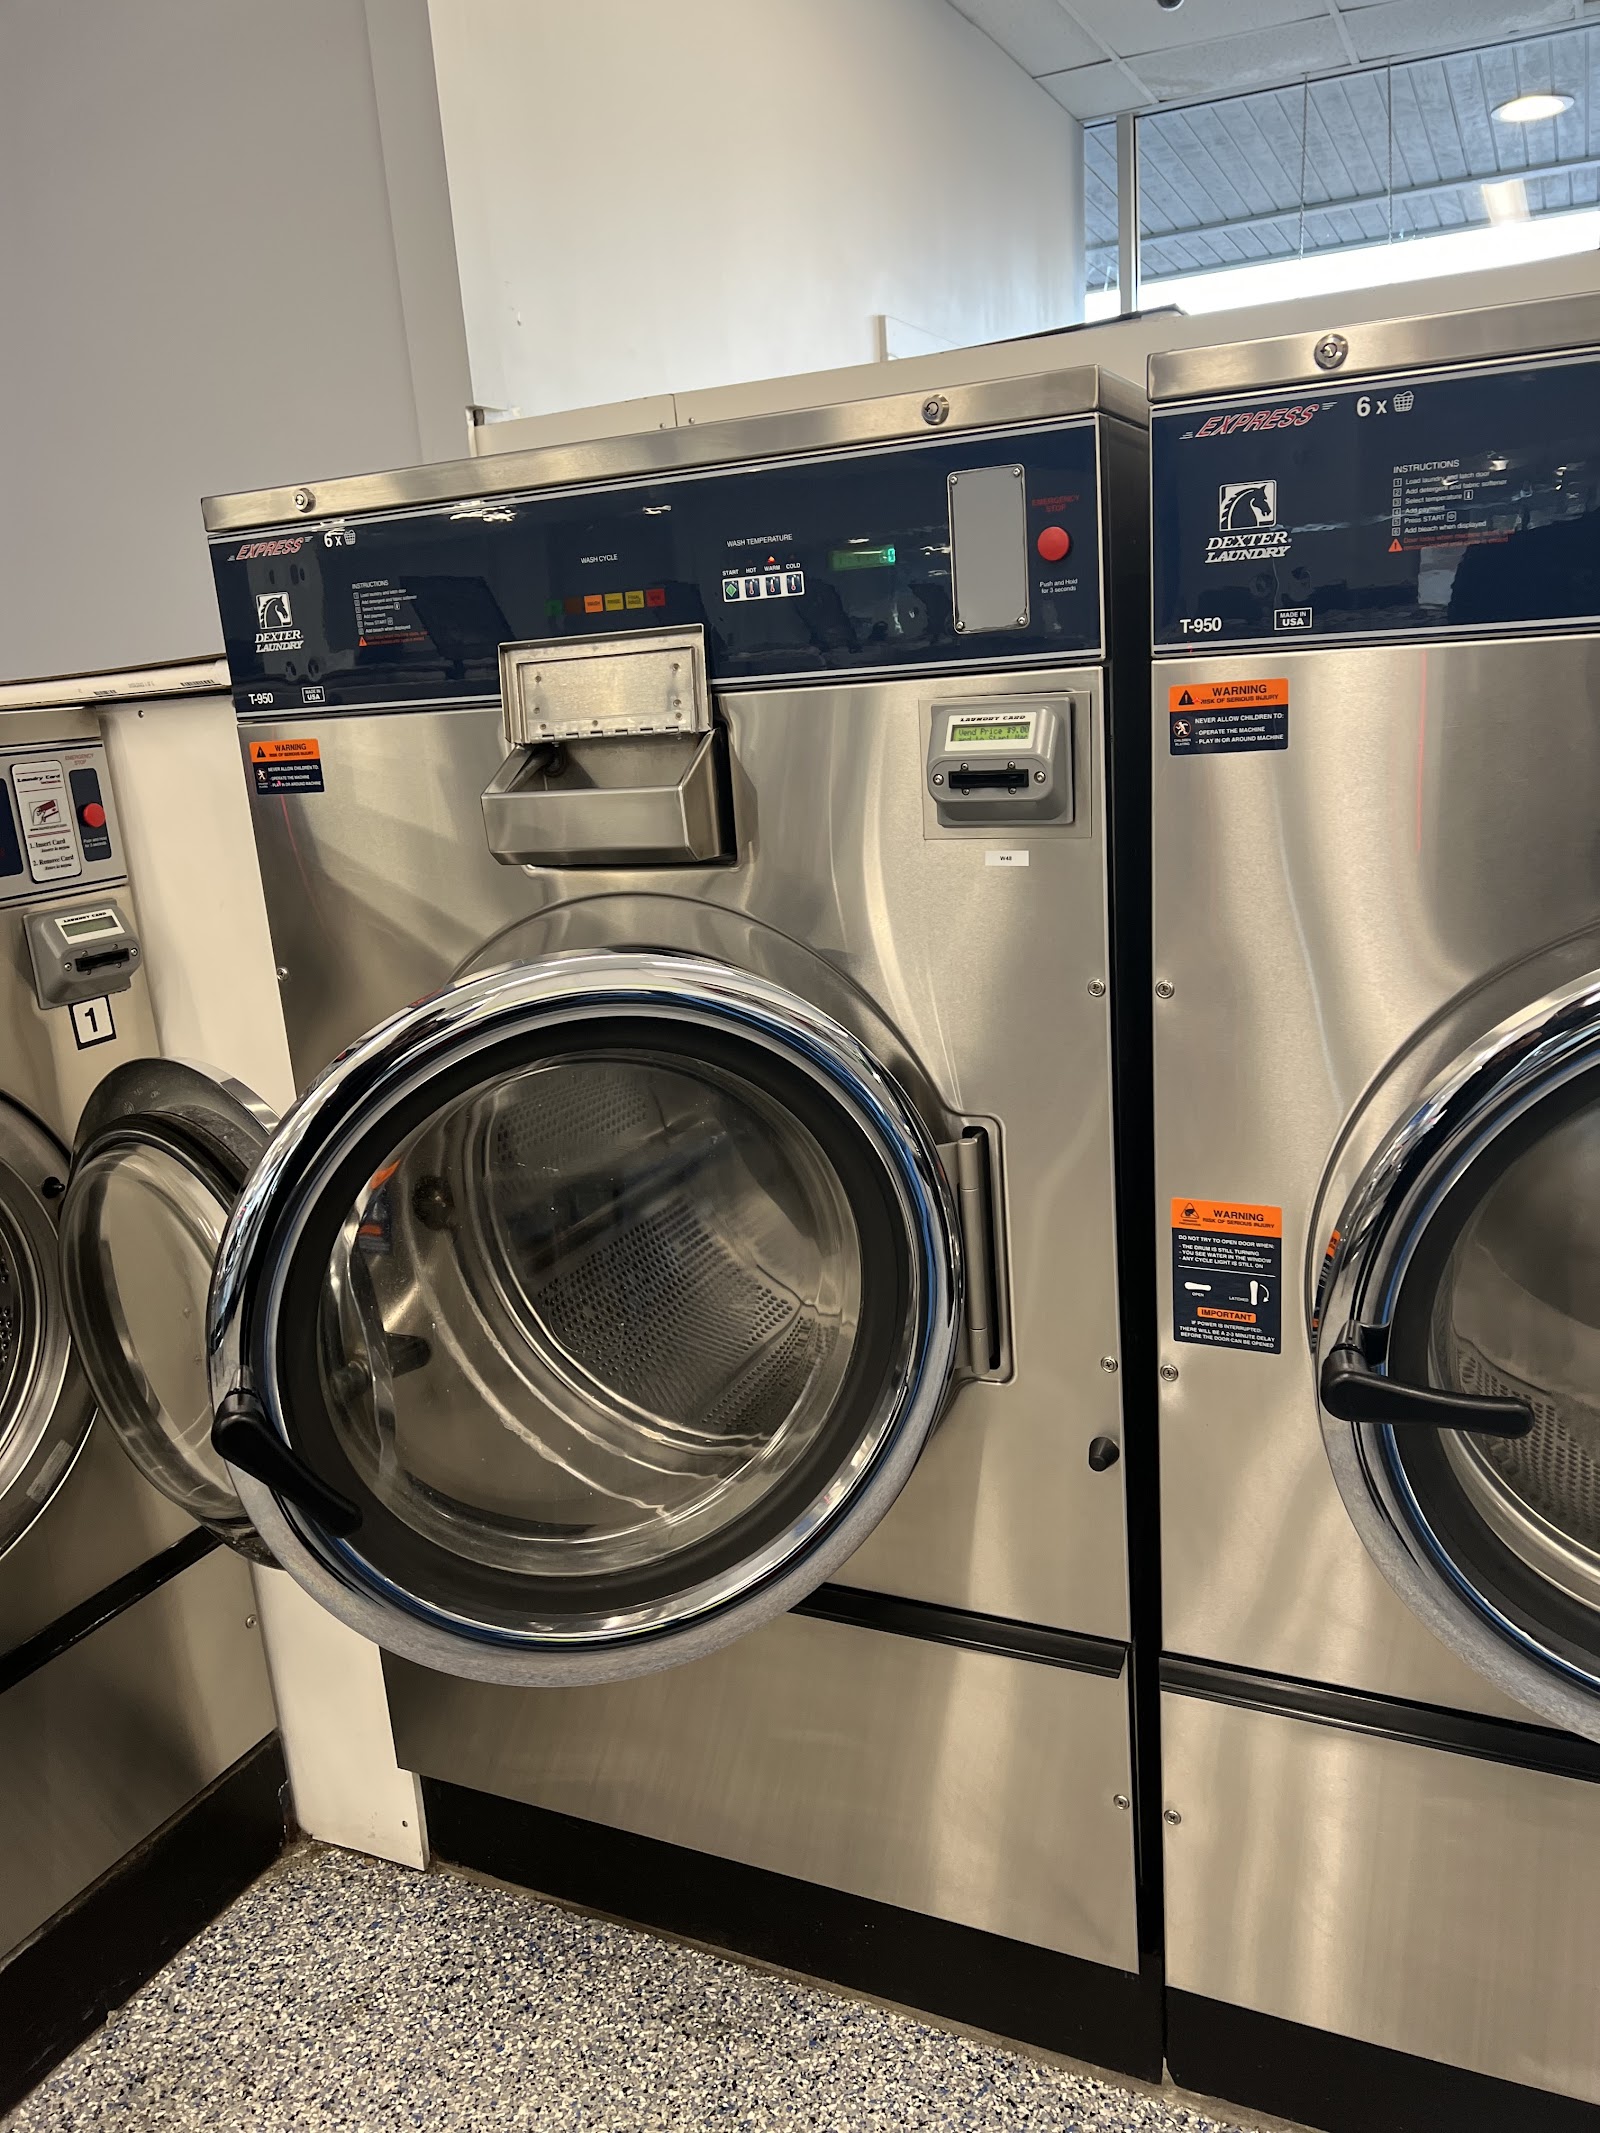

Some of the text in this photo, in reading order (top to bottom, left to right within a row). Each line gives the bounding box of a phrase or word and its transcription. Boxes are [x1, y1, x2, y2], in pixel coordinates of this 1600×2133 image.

[1356, 396, 1371, 417] 6
[1195, 404, 1319, 438] EXPRESS
[1394, 460, 1459, 473] INSTRUCTIONS
[1420, 486, 1448, 494] detergent
[1426, 494, 1462, 502] temperature
[1418, 506, 1445, 514] payment
[1457, 521, 1486, 529] displayed
[324, 533, 332, 547] 6
[746, 534, 792, 545] TEMPERATURE
[236, 537, 304, 560] EXPRESS
[1205, 546, 1291, 563] LAUNDRY
[352, 580, 388, 589] INSTRUCTIONS
[1180, 617, 1222, 633] T-950
[1282, 618, 1304, 626] USA
[256, 641, 304, 653] LAUNDRY
[1212, 684, 1267, 696] WARNING
[248, 693, 273, 704] T-950
[85, 1008, 98, 1032] 1
[1214, 1210, 1264, 1221] WARNING
[1202, 1309, 1252, 1320] IMPORTANT
